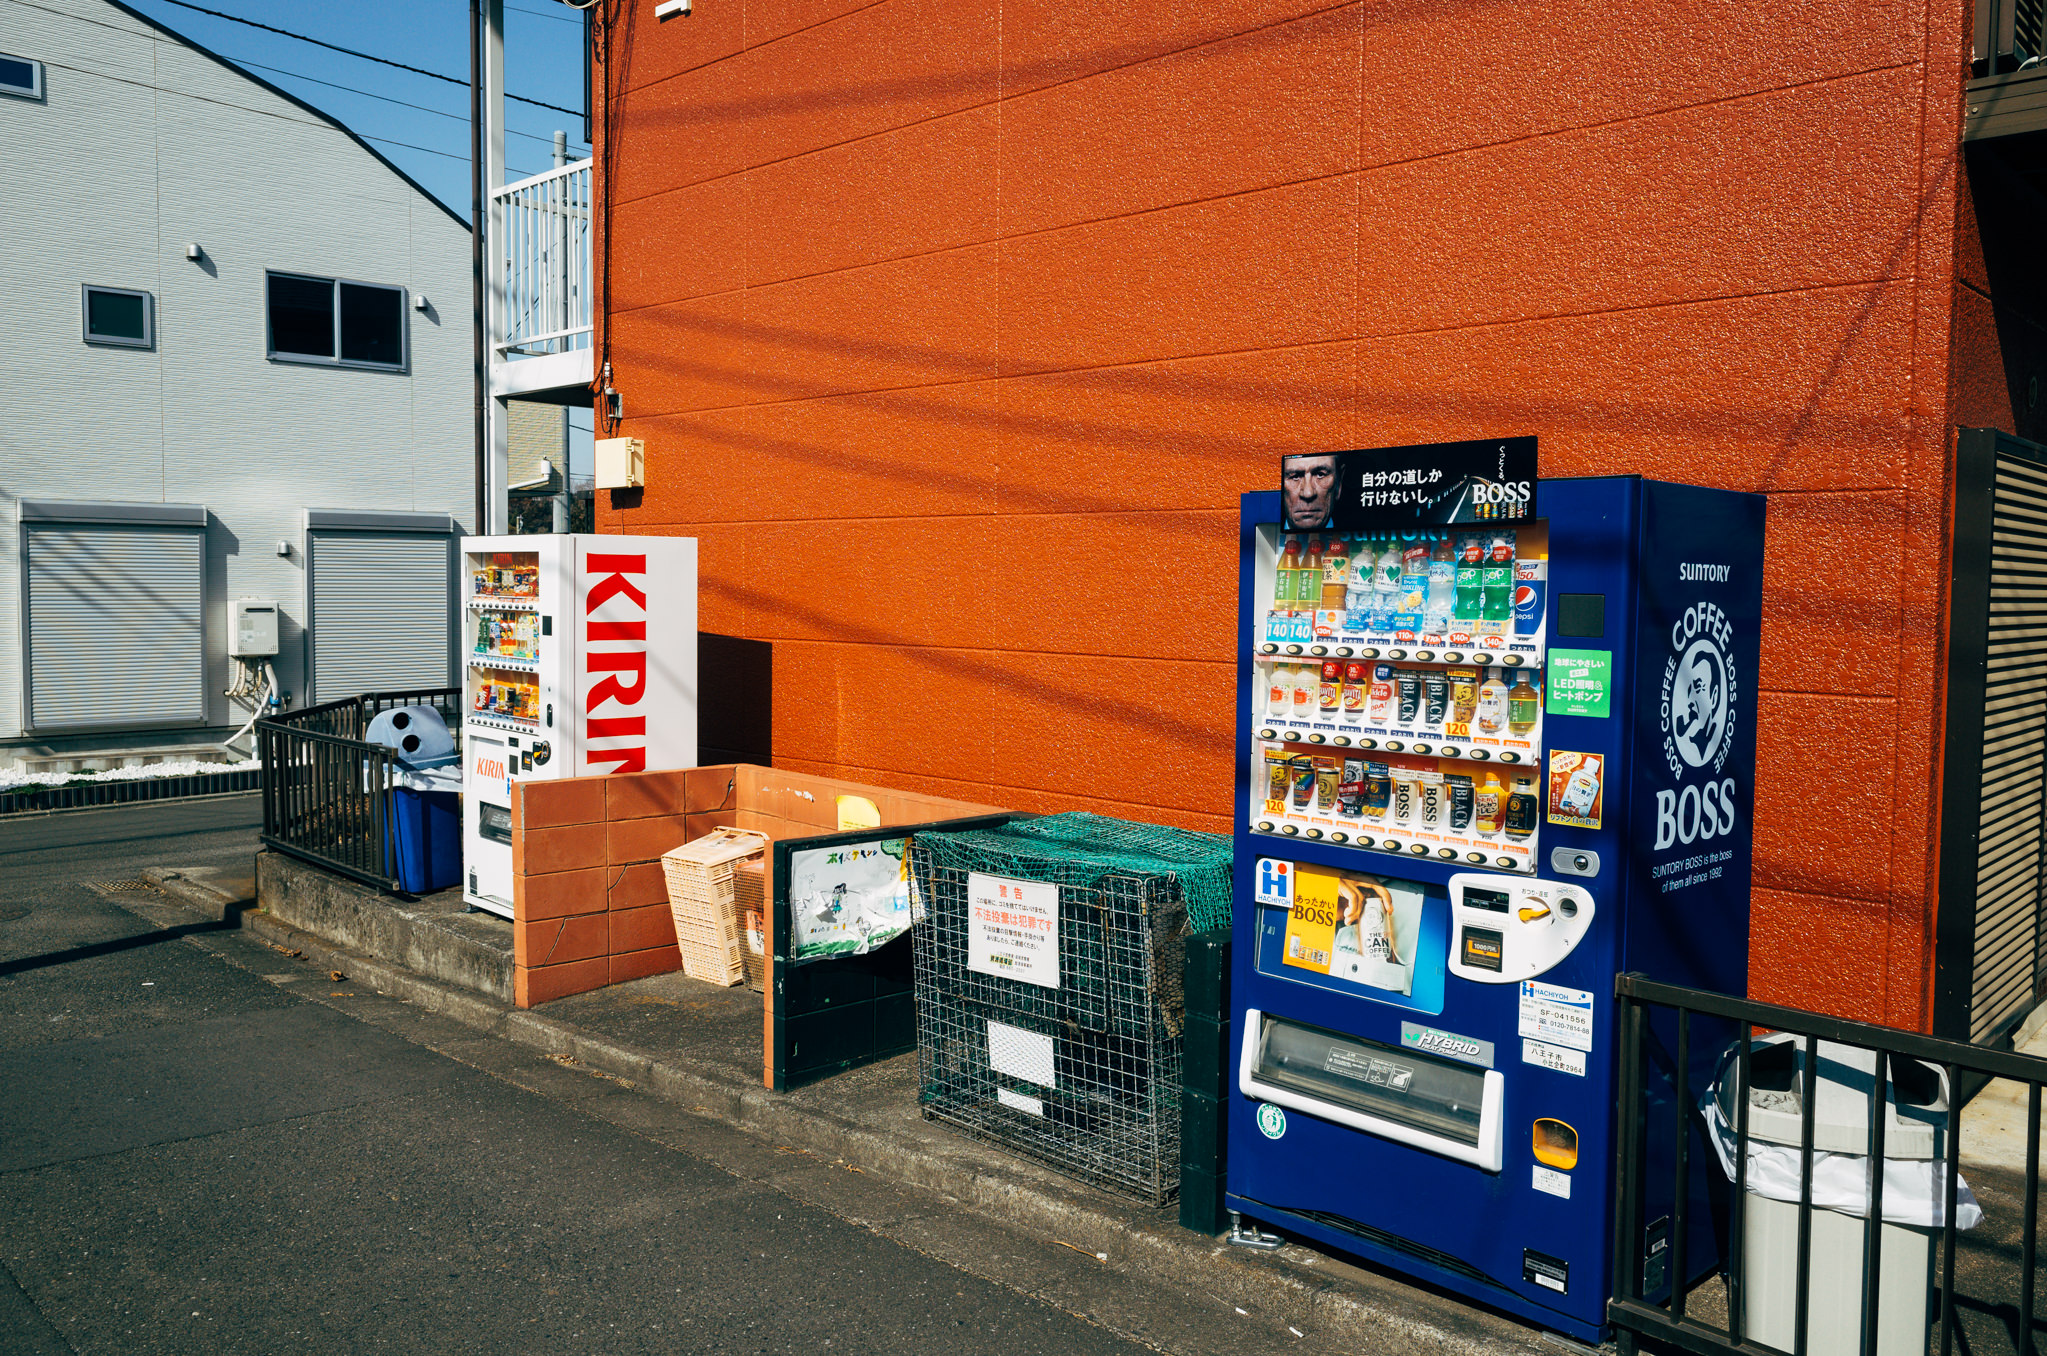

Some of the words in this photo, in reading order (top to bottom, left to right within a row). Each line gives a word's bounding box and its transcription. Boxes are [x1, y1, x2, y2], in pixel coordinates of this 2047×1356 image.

[1362, 469, 1443, 488] 自分の道しか
[1361, 489, 1434, 507] 行けないし。
[1472, 481, 1531, 504] BOSS
[1680, 562, 1731, 582] SUNTORY
[1267, 623, 1287, 638] 140
[1290, 624, 1311, 639] 140
[1672, 602, 1733, 652] COFFEE
[1725, 653, 1737, 703] BOSS
[1402, 682, 1414, 720] BLACK
[1429, 684, 1442, 723] BLACK
[1660, 655, 1677, 733] COFFEE
[1446, 723, 1468, 735] 120
[1714, 709, 1736, 775] COFFEE
[477, 757, 504, 781] KIRIN
[1663, 736, 1683, 781] BOSS
[1265, 800, 1284, 812] 120
[1398, 783, 1409, 818] BOSS
[1425, 787, 1437, 822] BOSS
[1455, 789, 1468, 827] BLACK
[1654, 777, 1735, 851] BOSS
[1652, 859, 1684, 878] SUNTORY
[1685, 855, 1703, 870] BOSS
[1703, 855, 1708, 865] is
[1709, 852, 1719, 863] the
[1719, 849, 1733, 861] boss
[1661, 880, 1668, 893] of
[1669, 876, 1684, 891] them
[1684, 873, 1692, 887] all
[1693, 871, 1708, 885] since
[1709, 866, 1723, 880] 1992
[1258, 895, 1291, 906] HACHIYOH
[1295, 895, 1335, 910] あったかい
[974, 906, 1053, 932] 不法投棄は犯罪です
[1294, 907, 1334, 927] BOSS
[1535, 988, 1569, 1001] HACHIYOH
[1540, 1009, 1586, 1025] SF-041556
[1418, 1032, 1481, 1056] HYBRID
[1531, 1049, 1563, 1062] 八王子市
